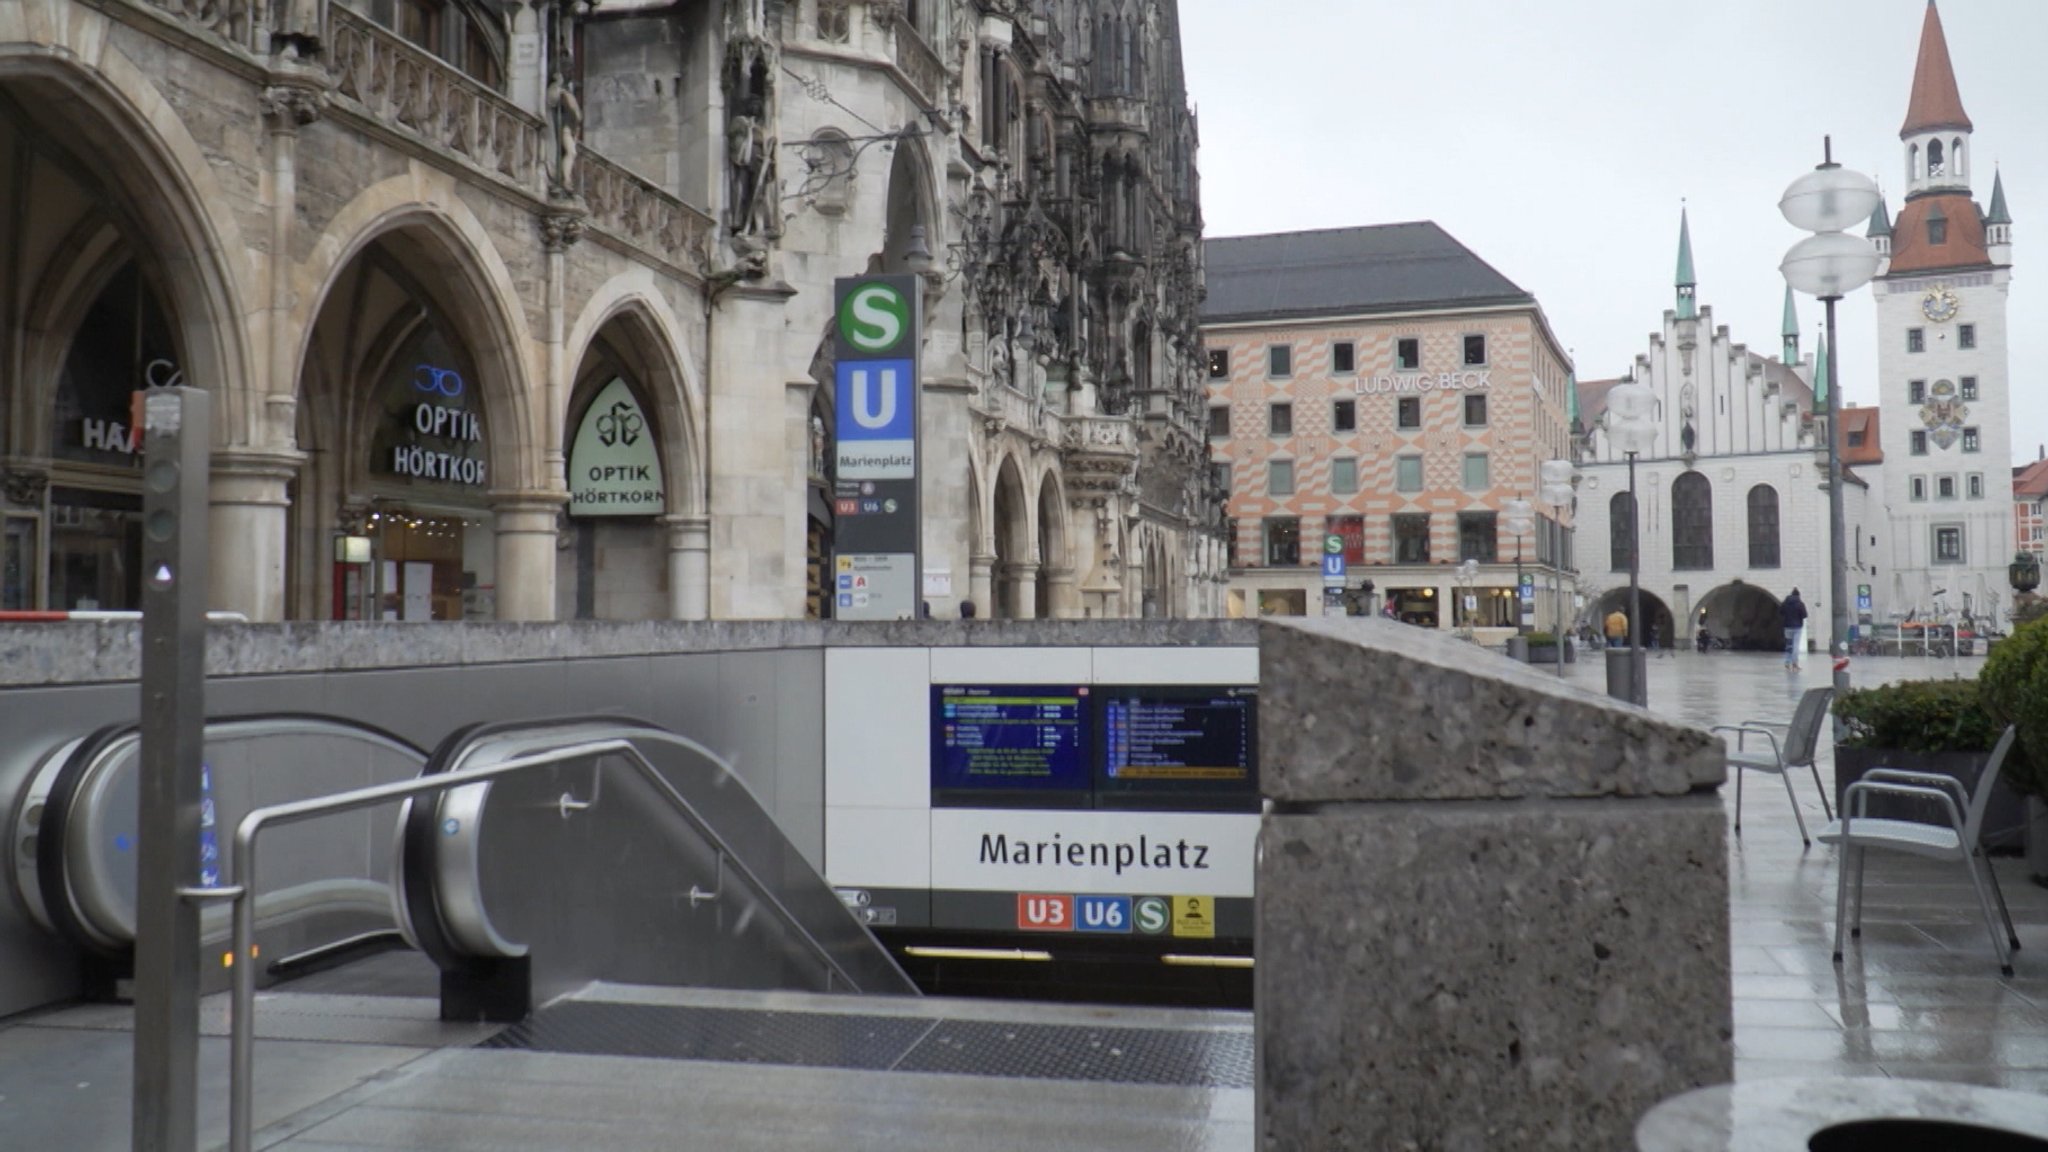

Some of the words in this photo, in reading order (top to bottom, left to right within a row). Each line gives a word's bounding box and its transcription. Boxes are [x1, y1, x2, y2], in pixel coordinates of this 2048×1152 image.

[852, 287, 900, 349] S
[1354, 374, 1433, 395] LUDWIG
[1439, 370, 1492, 391] BECK
[852, 369, 897, 430] U
[415, 402, 480, 441] OPTIK
[588, 463, 651, 483] OPTIK
[839, 453, 913, 469] Marienplatz
[1326, 535, 1342, 554] S
[1327, 556, 1342, 575] U
[979, 832, 1210, 876] Marienplatz
[1027, 898, 1065, 925] U3
[1084, 901, 1123, 928] U6
[1140, 900, 1164, 930] S
